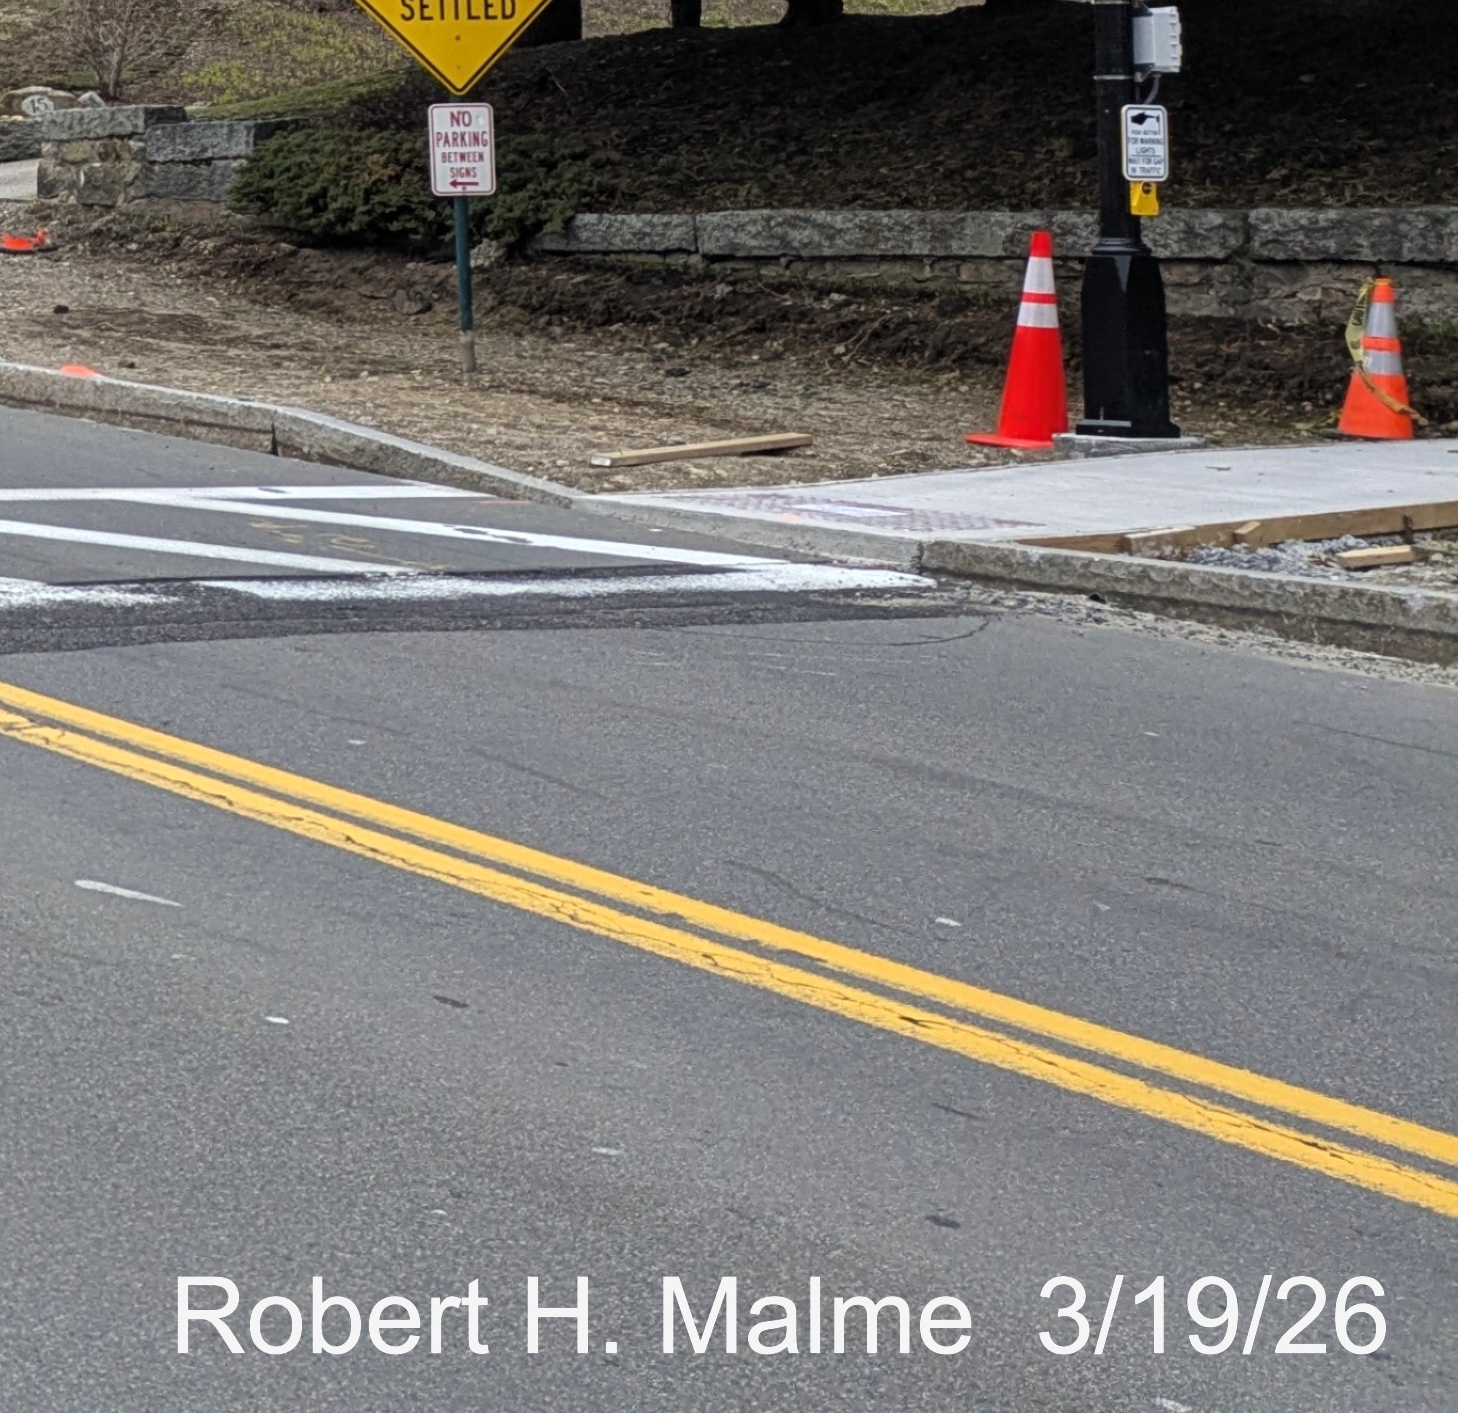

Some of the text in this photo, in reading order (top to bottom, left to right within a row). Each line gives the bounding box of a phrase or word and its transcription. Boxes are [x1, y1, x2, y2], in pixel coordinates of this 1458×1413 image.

[30, 98, 49, 113] 15
[450, 110, 472, 127] NO
[436, 131, 488, 148] PARKING
[441, 151, 484, 163] BETWEEN
[449, 166, 477, 179] SIGNS
